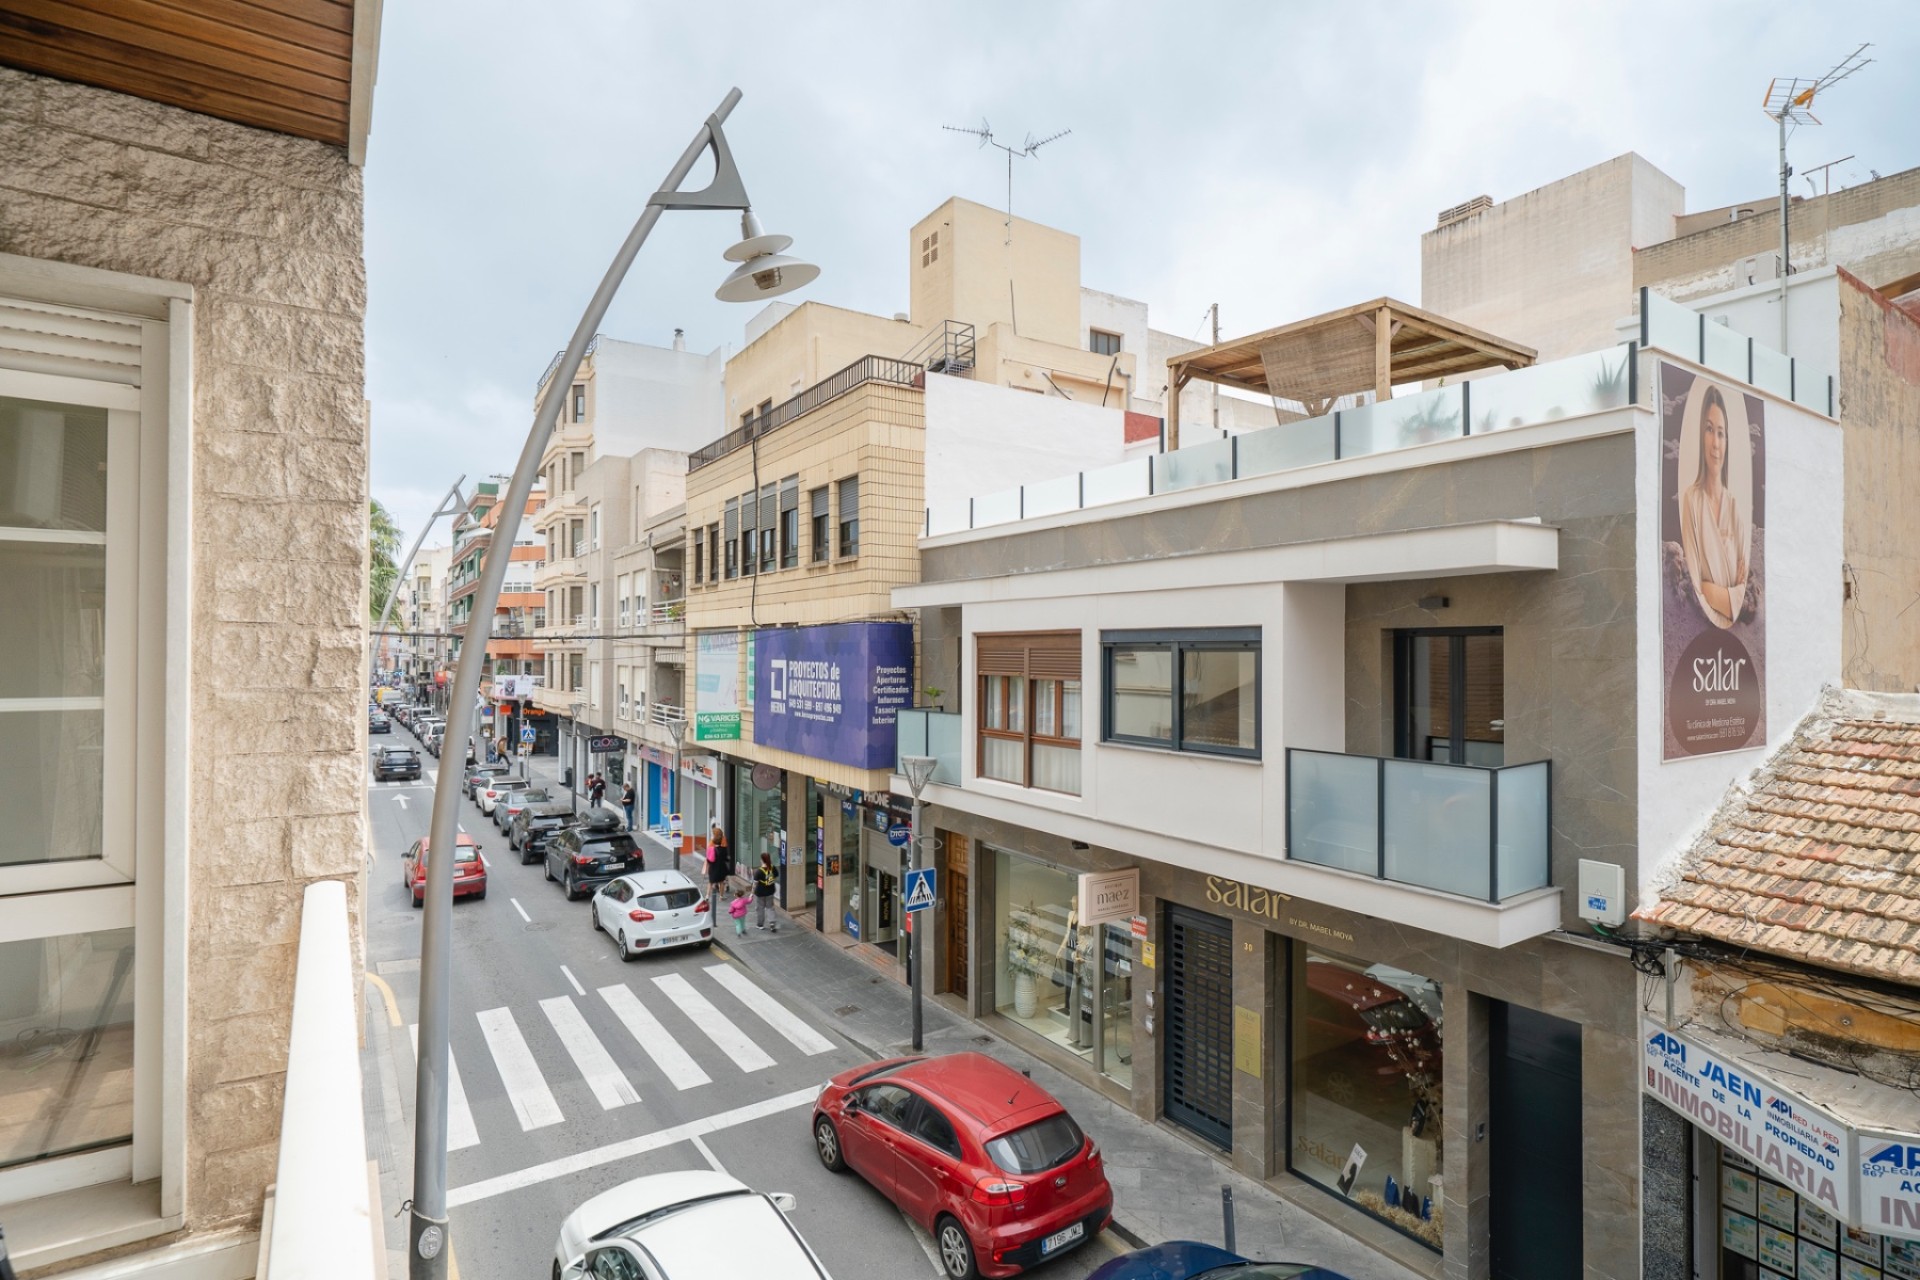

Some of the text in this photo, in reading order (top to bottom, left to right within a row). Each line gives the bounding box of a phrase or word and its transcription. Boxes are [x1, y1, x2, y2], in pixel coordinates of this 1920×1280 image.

[788, 660, 841, 681] PROYECTOS de
[876, 665, 906, 675] Proyectos
[1692, 648, 1746, 693] salar
[788, 678, 842, 701] ARQUITECTURA
[872, 685, 909, 694] Certificados
[876, 676, 906, 685] Aperturas
[877, 695, 905, 704] Informes
[522, 708, 546, 717] Orange
[710, 713, 740, 724] VARICES
[592, 737, 620, 748] GLOSS
[863, 791, 891, 808] PHONE
[1097, 888, 1131, 905] maez
[1206, 875, 1293, 920] salar
[1289, 917, 1298, 926] BY
[1309, 923, 1333, 937] MABEL
[1333, 929, 1354, 942] MOYA
[1243, 942, 1254, 952] 30
[1649, 1032, 1762, 1109] API JAEN
[1664, 1060, 1836, 1172] AGENTE DE LA PROPIEDAD
[1766, 1110, 1819, 1146] INMOBILIARIA
[1811, 1123, 1839, 1145] LA RED
[1658, 1071, 1840, 1212] INMOBILIARIA
